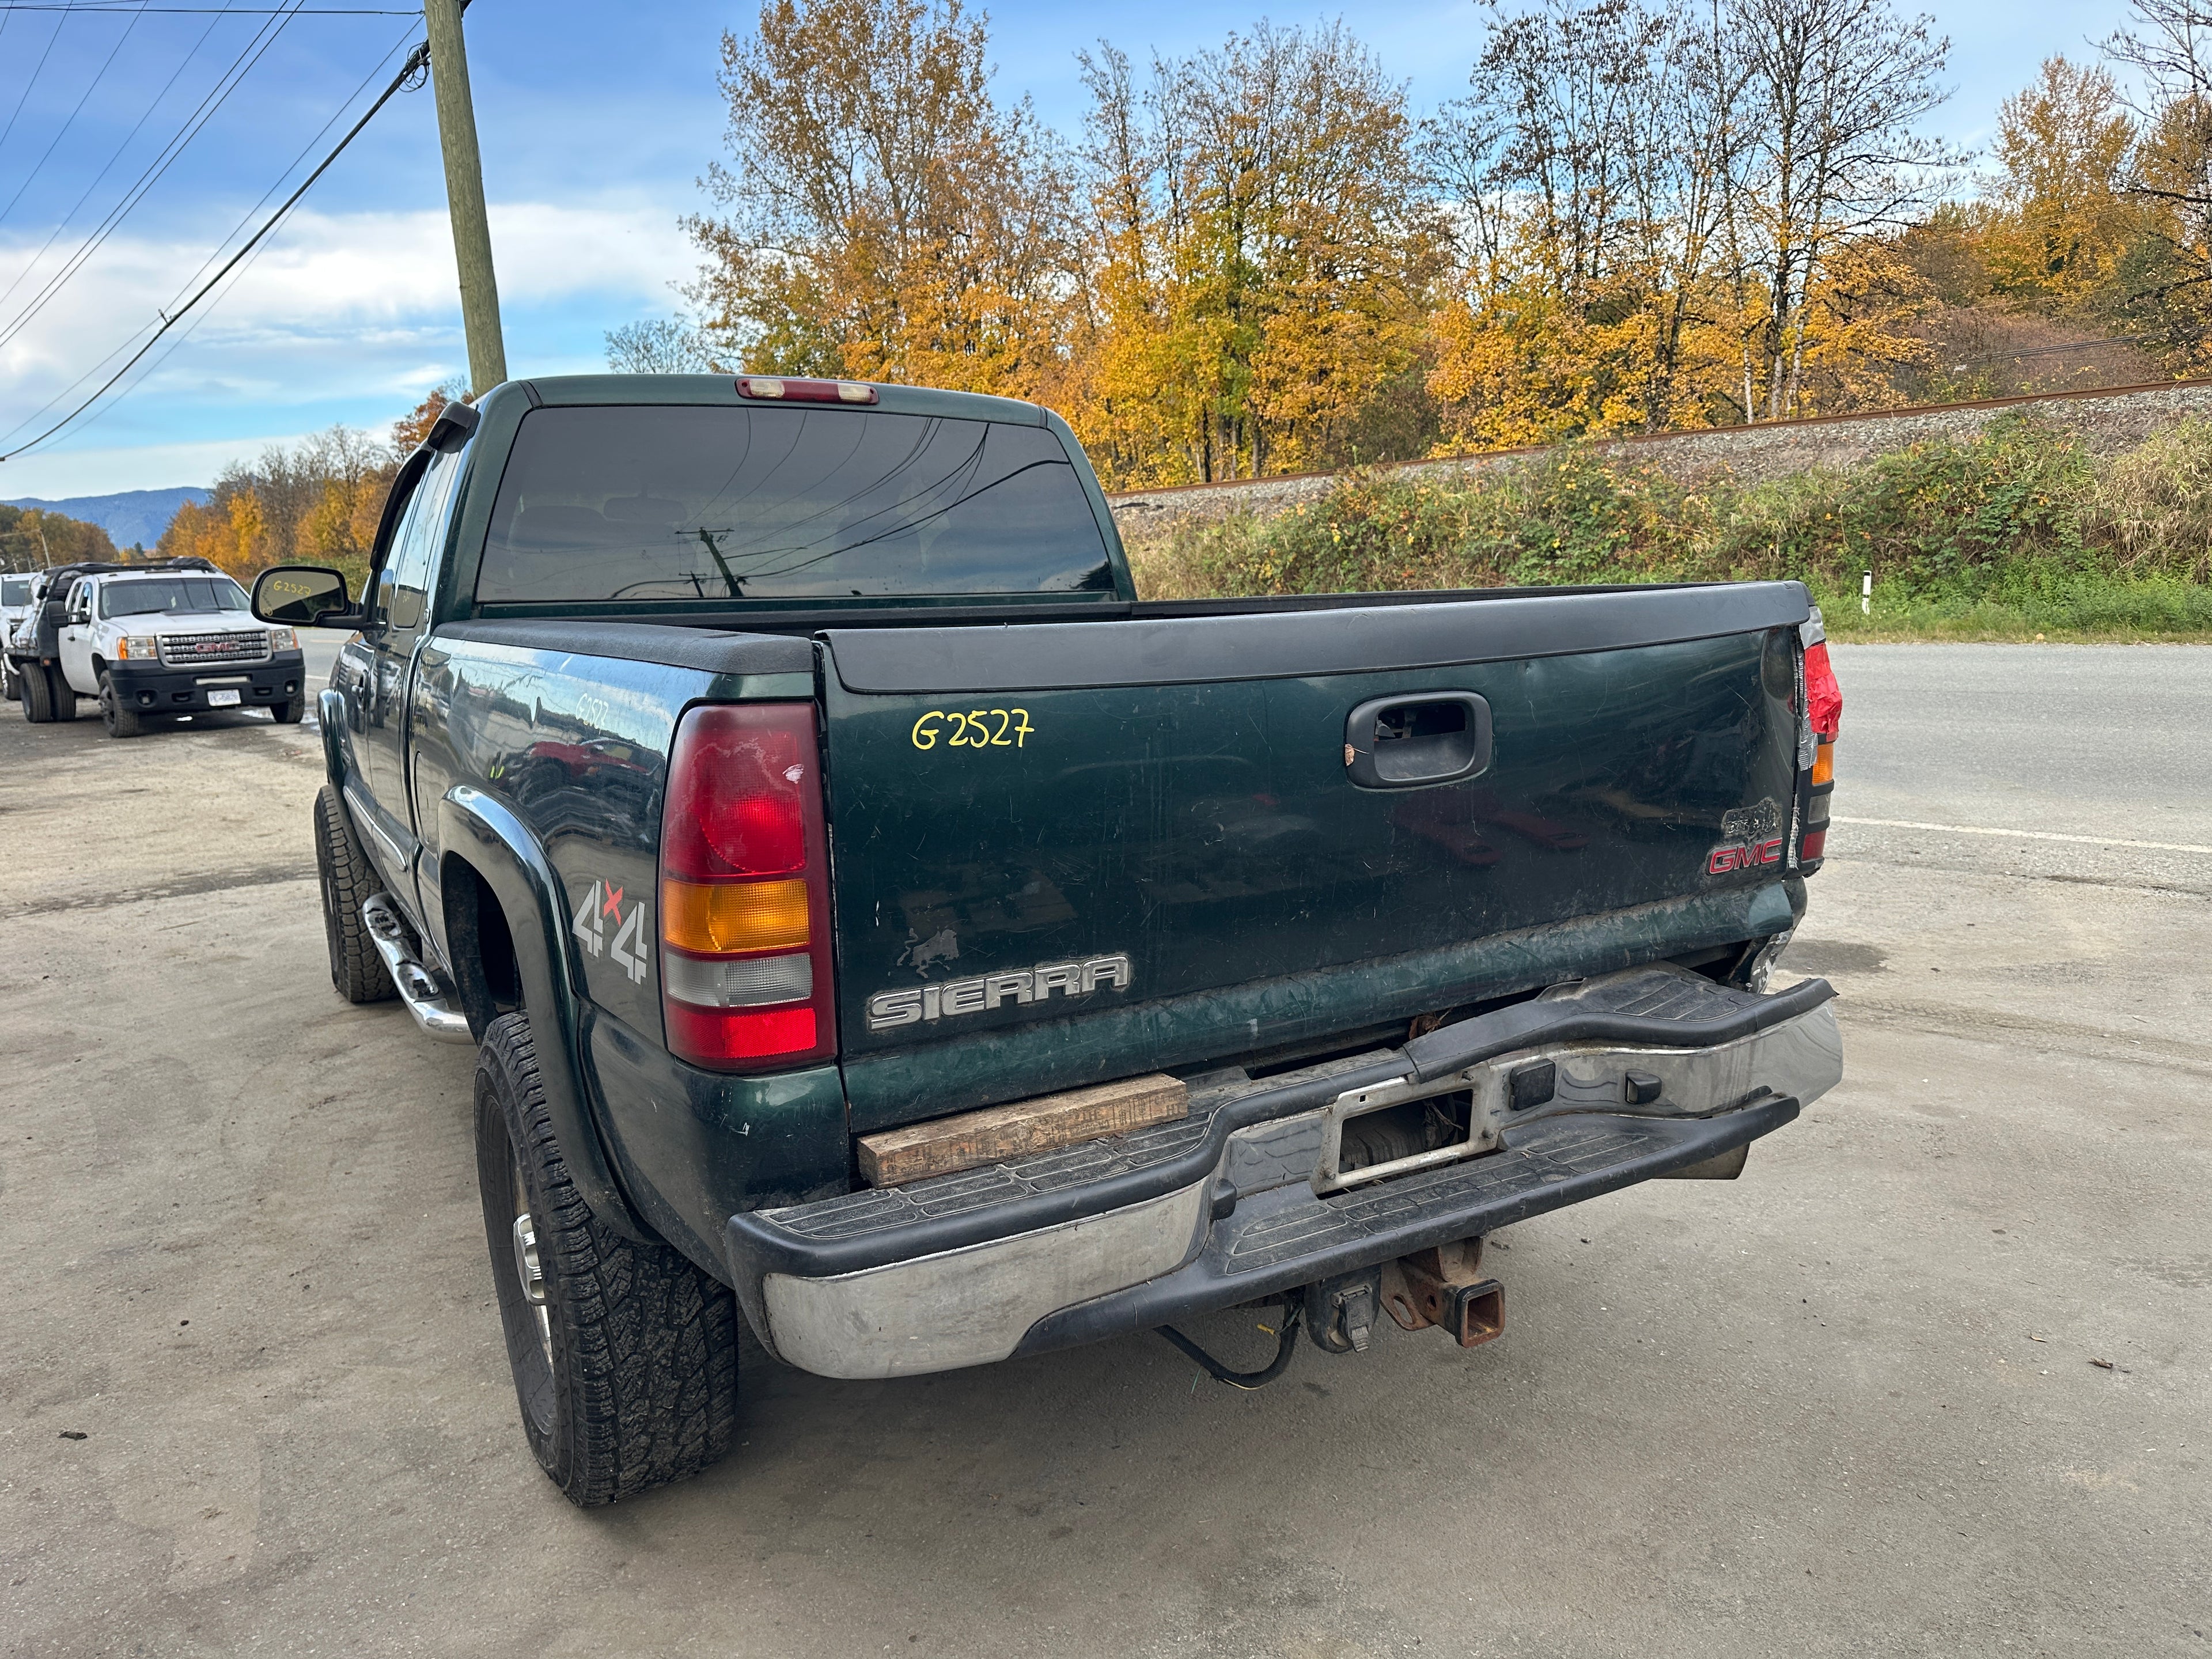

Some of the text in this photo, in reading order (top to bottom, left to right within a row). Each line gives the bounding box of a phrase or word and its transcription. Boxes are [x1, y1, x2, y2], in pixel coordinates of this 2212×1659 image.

[273, 580, 312, 597] G2527
[196, 641, 240, 653] GMC
[576, 692, 609, 734] G2527
[911, 708, 1035, 750] G2527
[1709, 837, 1783, 874] GMC
[869, 954, 1130, 1031] SIERRA
